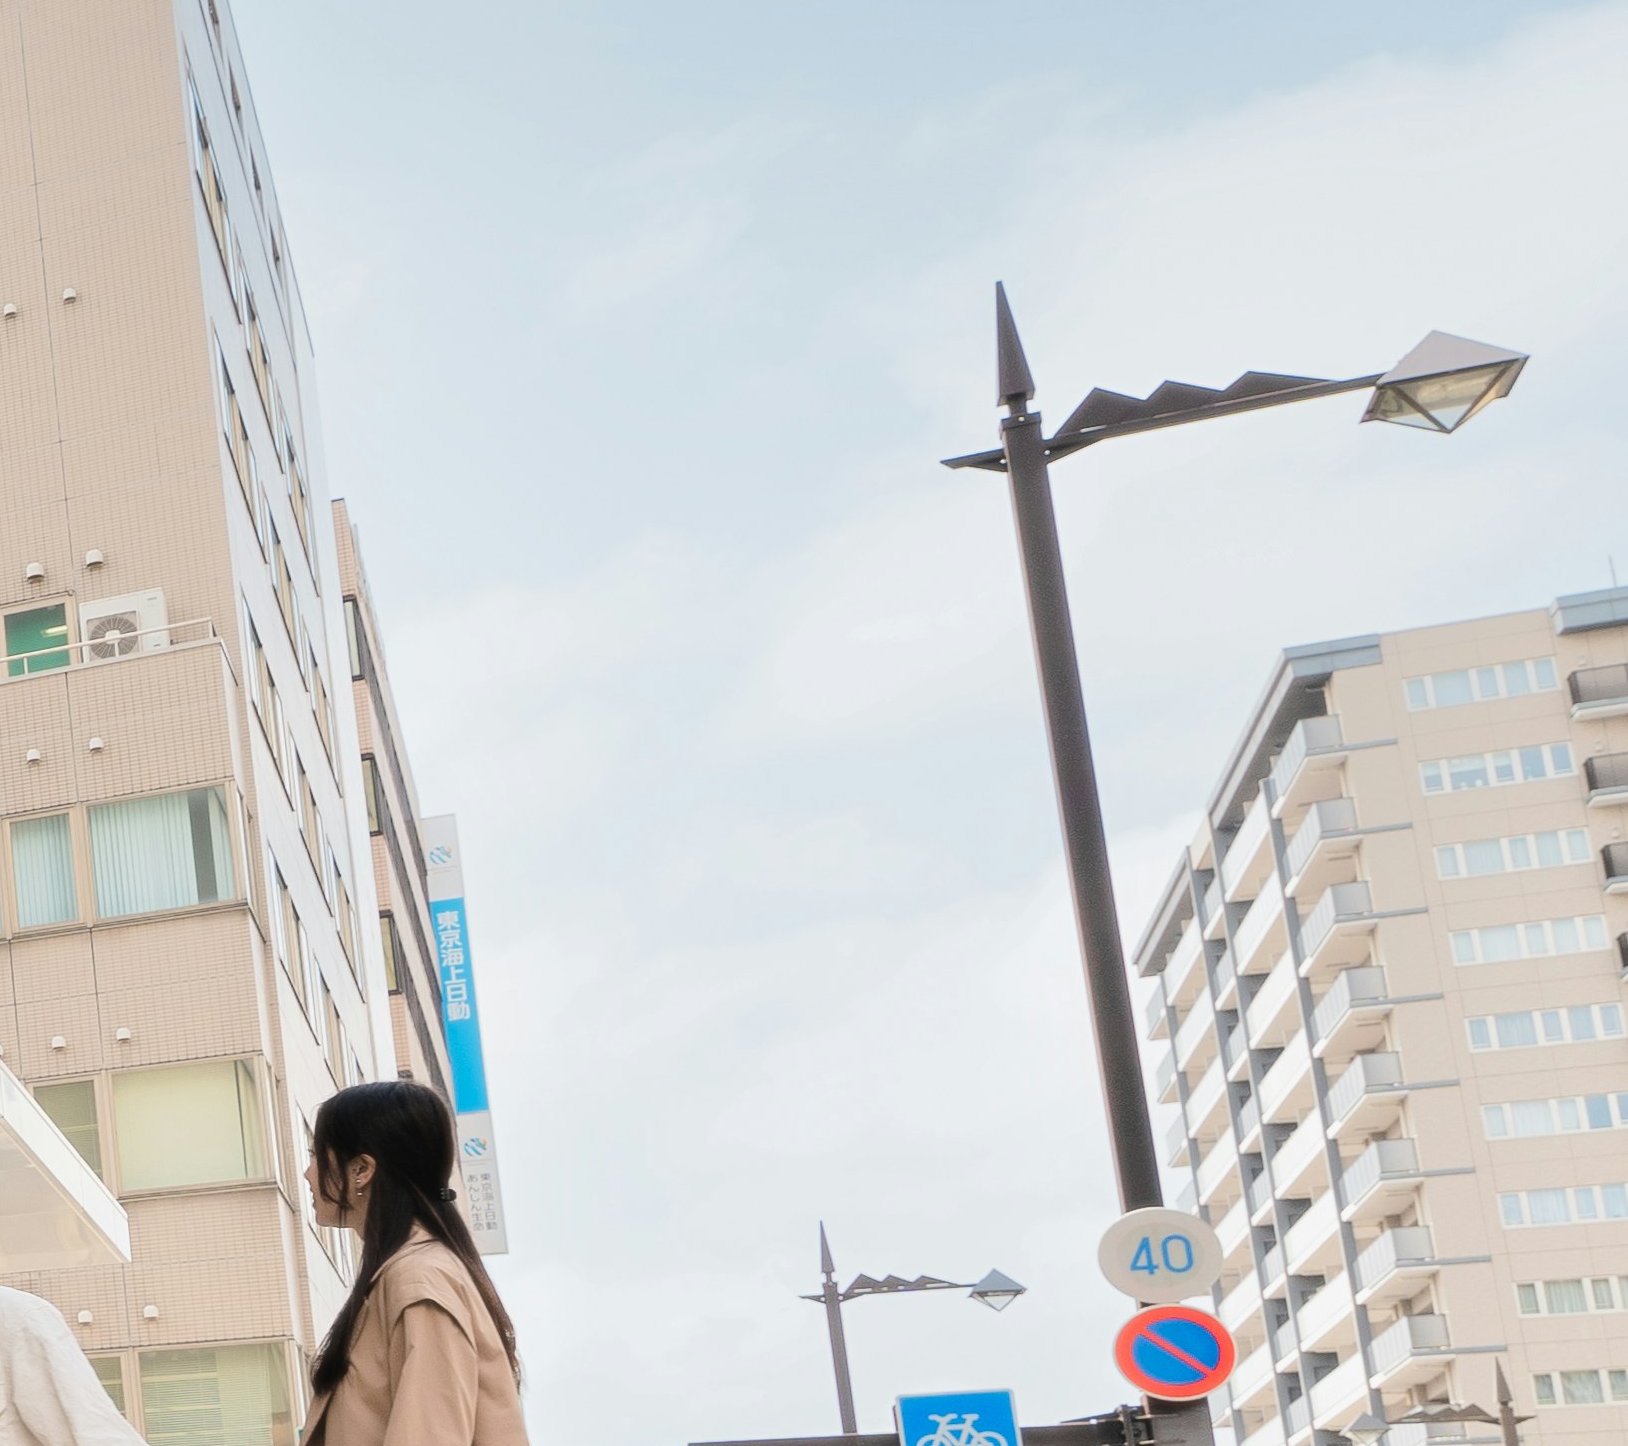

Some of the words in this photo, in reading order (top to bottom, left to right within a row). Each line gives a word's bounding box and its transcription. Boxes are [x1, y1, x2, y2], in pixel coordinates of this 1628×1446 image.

[436, 910, 471, 1021] 東京海上日動
[468, 1173, 485, 1232] あんしん生命
[480, 1173, 498, 1230] 東京海上日動
[1129, 1234, 1195, 1276] 40
